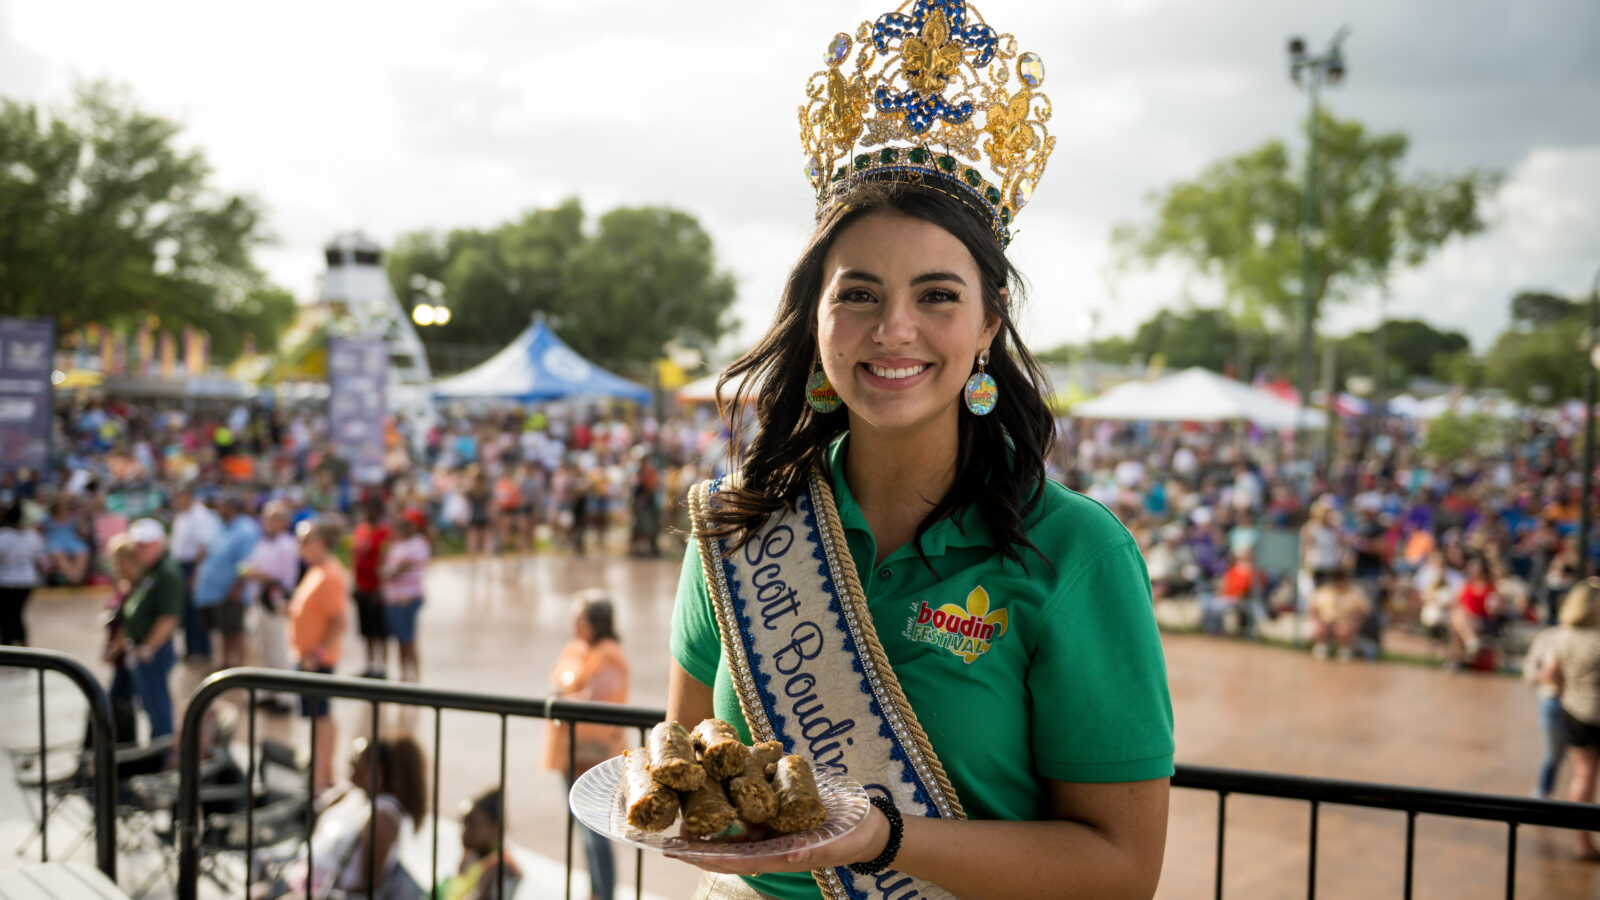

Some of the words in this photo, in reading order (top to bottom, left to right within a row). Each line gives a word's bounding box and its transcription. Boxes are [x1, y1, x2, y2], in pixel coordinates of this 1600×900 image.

[745, 525, 801, 631] Scott
[911, 624, 985, 654] FESTIVAL
[916, 600, 994, 640] boudin
